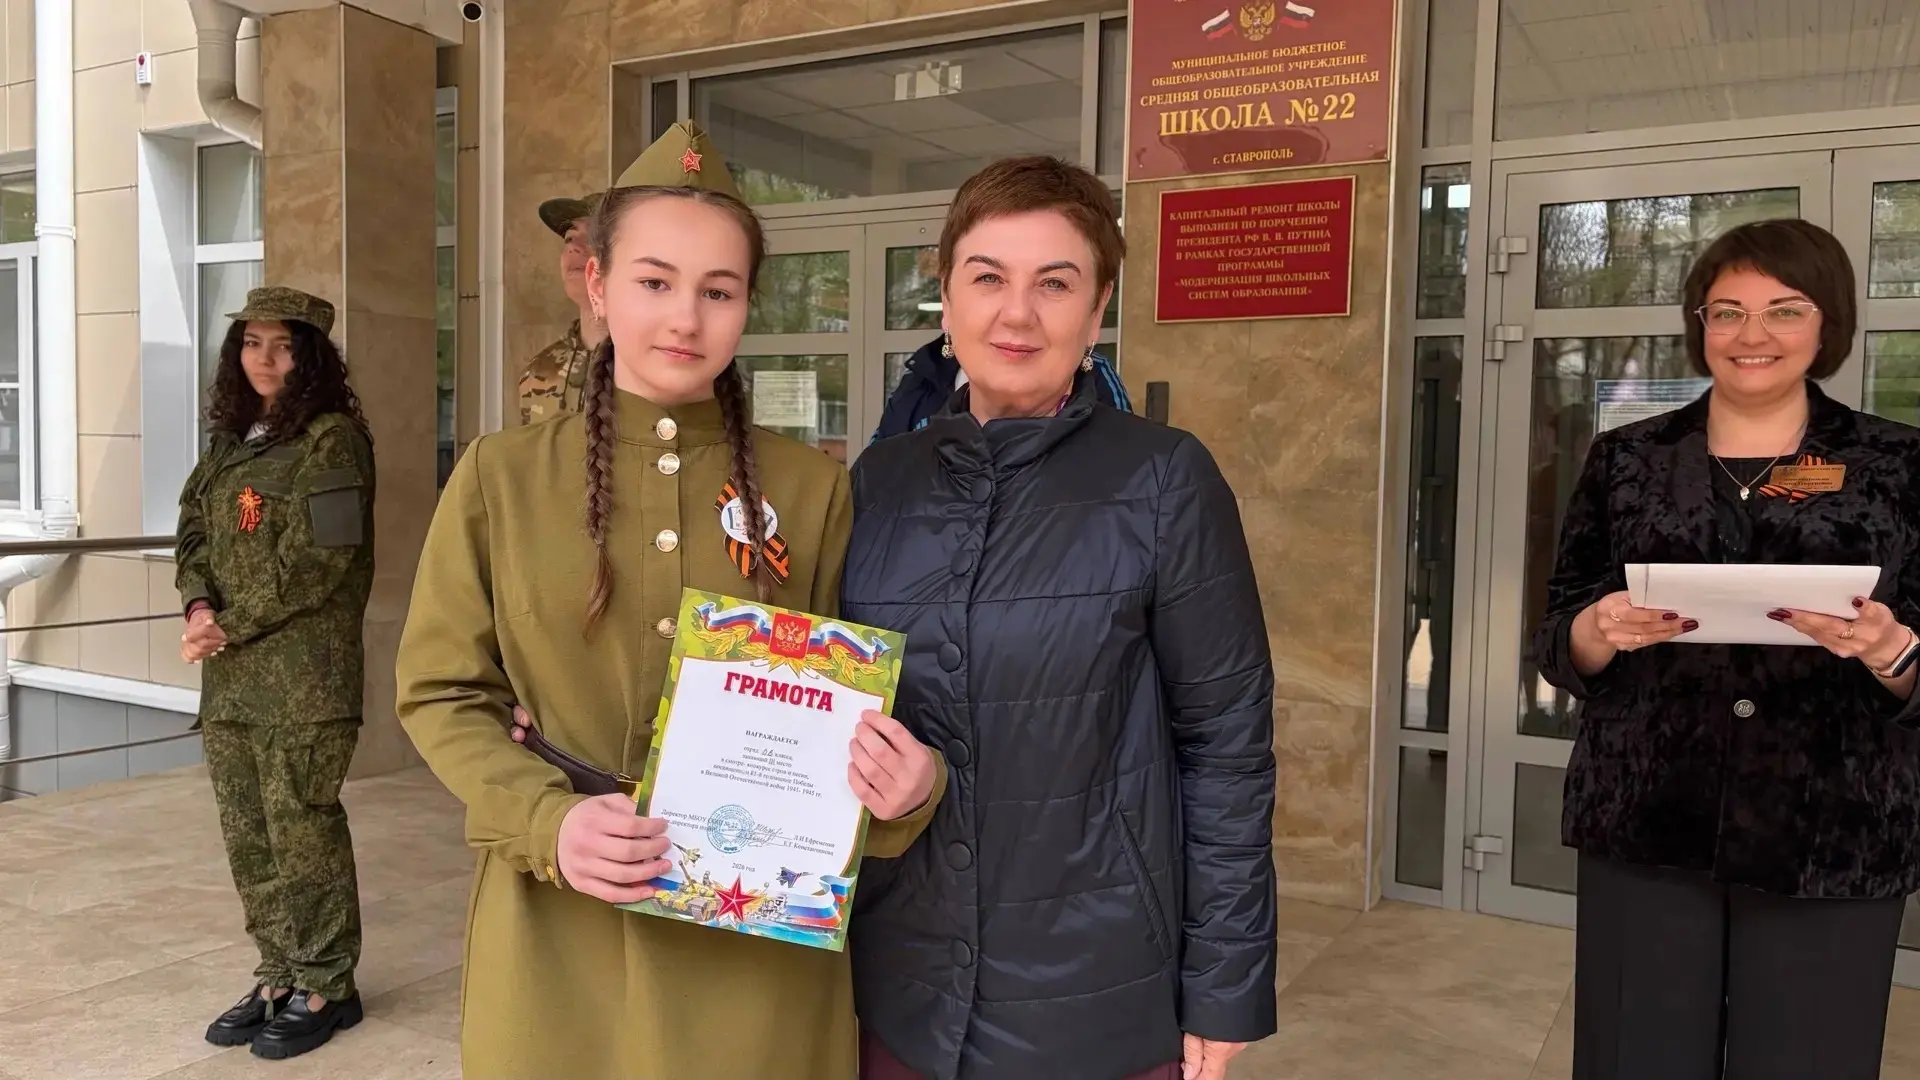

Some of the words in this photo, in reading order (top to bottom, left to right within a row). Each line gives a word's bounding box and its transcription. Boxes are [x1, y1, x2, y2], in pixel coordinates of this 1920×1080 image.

[1172, 50, 1269, 70] МУНИЦИПАЛЬНОЕ
[1272, 41, 1347, 58] БЮДЖЕТНОЕ
[1152, 63, 1284, 86] ОБЩЕОБРАЗОВАТЕЛЬНОЕ
[1288, 54, 1367, 71] УЧРЕЖДЕНИЕ
[1140, 90, 1199, 107] СРЕДНЯЯ
[1203, 70, 1380, 99] ОБЩЕОБРАЗОВАТЕЛЬНАЯ
[1159, 101, 1275, 136] ШКОЛА
[1213, 157, 1220, 165] г.
[1223, 148, 1294, 164] СТАВРОПОЛЬ
[1169, 206, 1247, 221] КАПИТАЛЬНЫЙ
[1251, 203, 1293, 216] РЕМОНТ
[1296, 200, 1341, 212] ШКОЛЫ
[1180, 222, 1239, 234] ВЫПОЛНЕН
[1241, 219, 1256, 230] ПО
[1259, 215, 1328, 229] ПОРУЧЕНИЮ
[1176, 235, 1242, 247] ПРЕЗИДЕНТА
[1244, 233, 1260, 244] РФ
[1287, 230, 1332, 241] ПУТИНА
[1176, 252, 1182, 260] В
[1185, 250, 1225, 260] РАМКАХ
[1228, 243, 1331, 258] ГОСУДАРСТВЕННОЙ
[1217, 260, 1285, 271] ПРОГРАММЫ
[1265, 271, 1331, 282] ШКОЛЬНЫХ
[1188, 290, 1230, 300] СИСТЕМ
[724, 671, 834, 712] ГРАМОТА
[745, 729, 799, 745] НАГРАЖДАЕТСЯ
